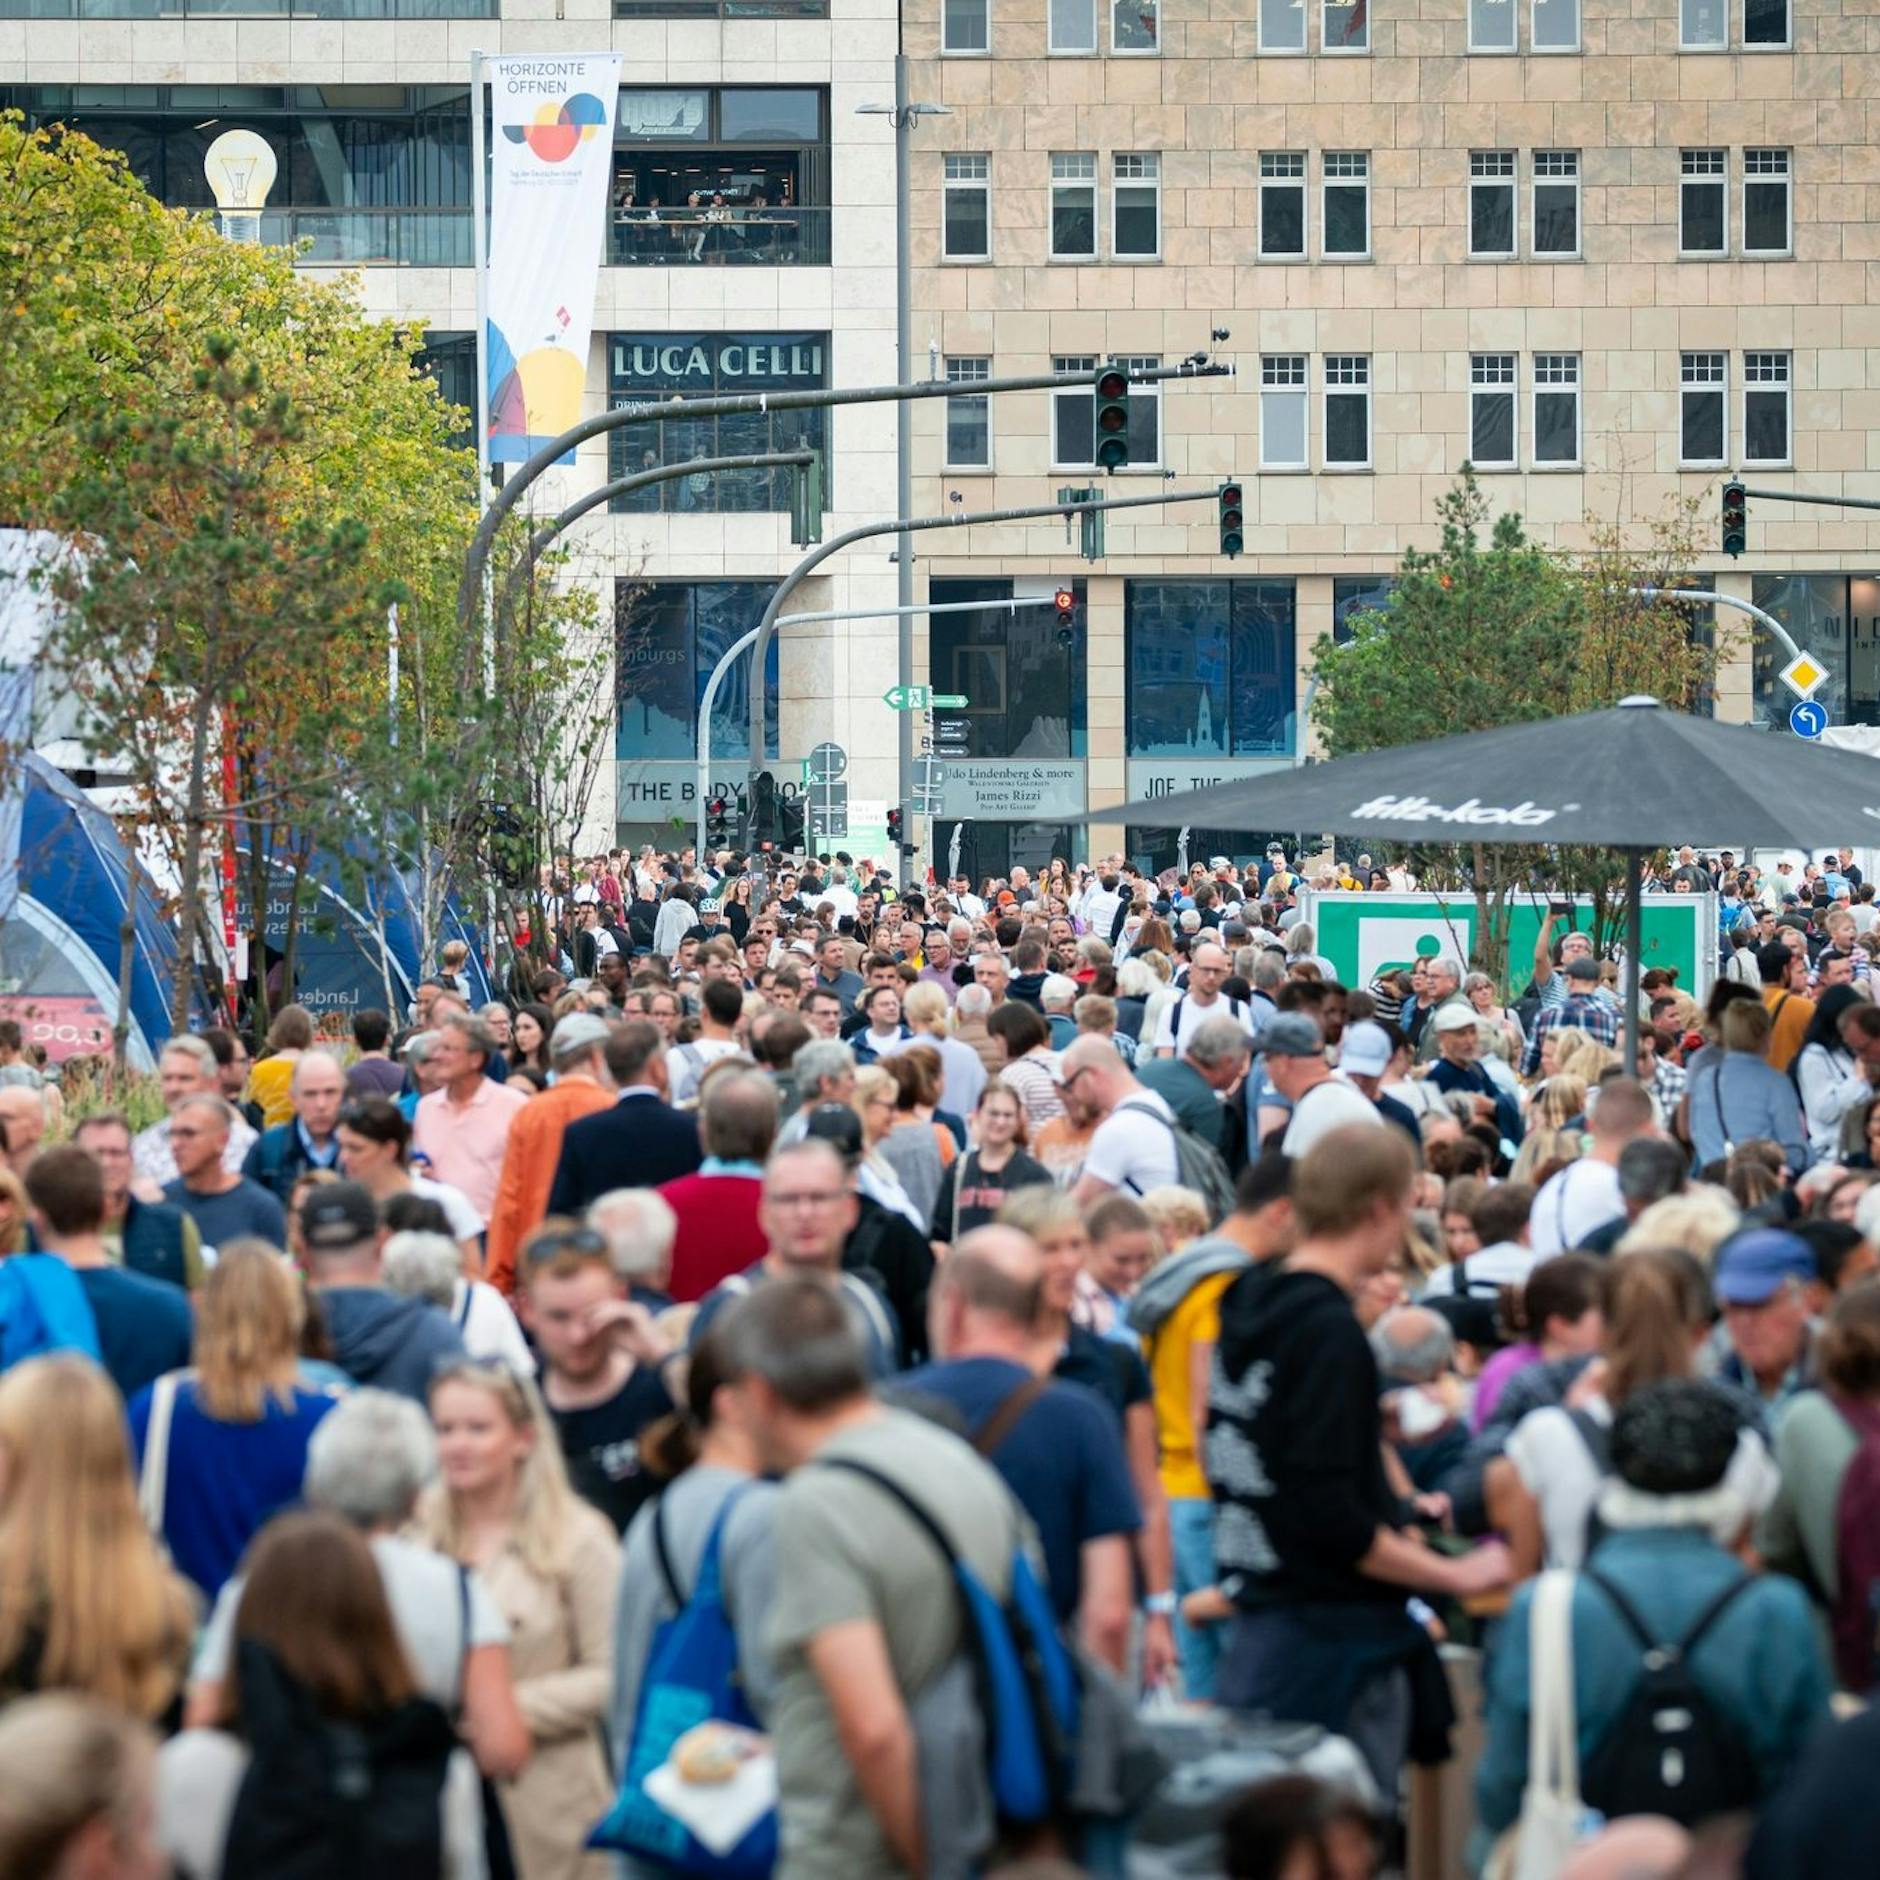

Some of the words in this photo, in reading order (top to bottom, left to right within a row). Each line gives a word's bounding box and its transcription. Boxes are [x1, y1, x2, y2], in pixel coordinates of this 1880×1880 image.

[499, 62, 586, 76] HORIZONTE
[507, 76, 567, 94] ÖFFNEN
[614, 346, 711, 376] LUCA
[719, 346, 822, 376] CELLI
[969, 768, 1029, 780] Lindenberg
[1032, 768, 1044, 778] &
[1047, 771, 1074, 779] more
[627, 782, 672, 801] THE
[681, 782, 744, 801] BDY
[975, 790, 1010, 802] James
[1013, 790, 1041, 801] Rizzi
